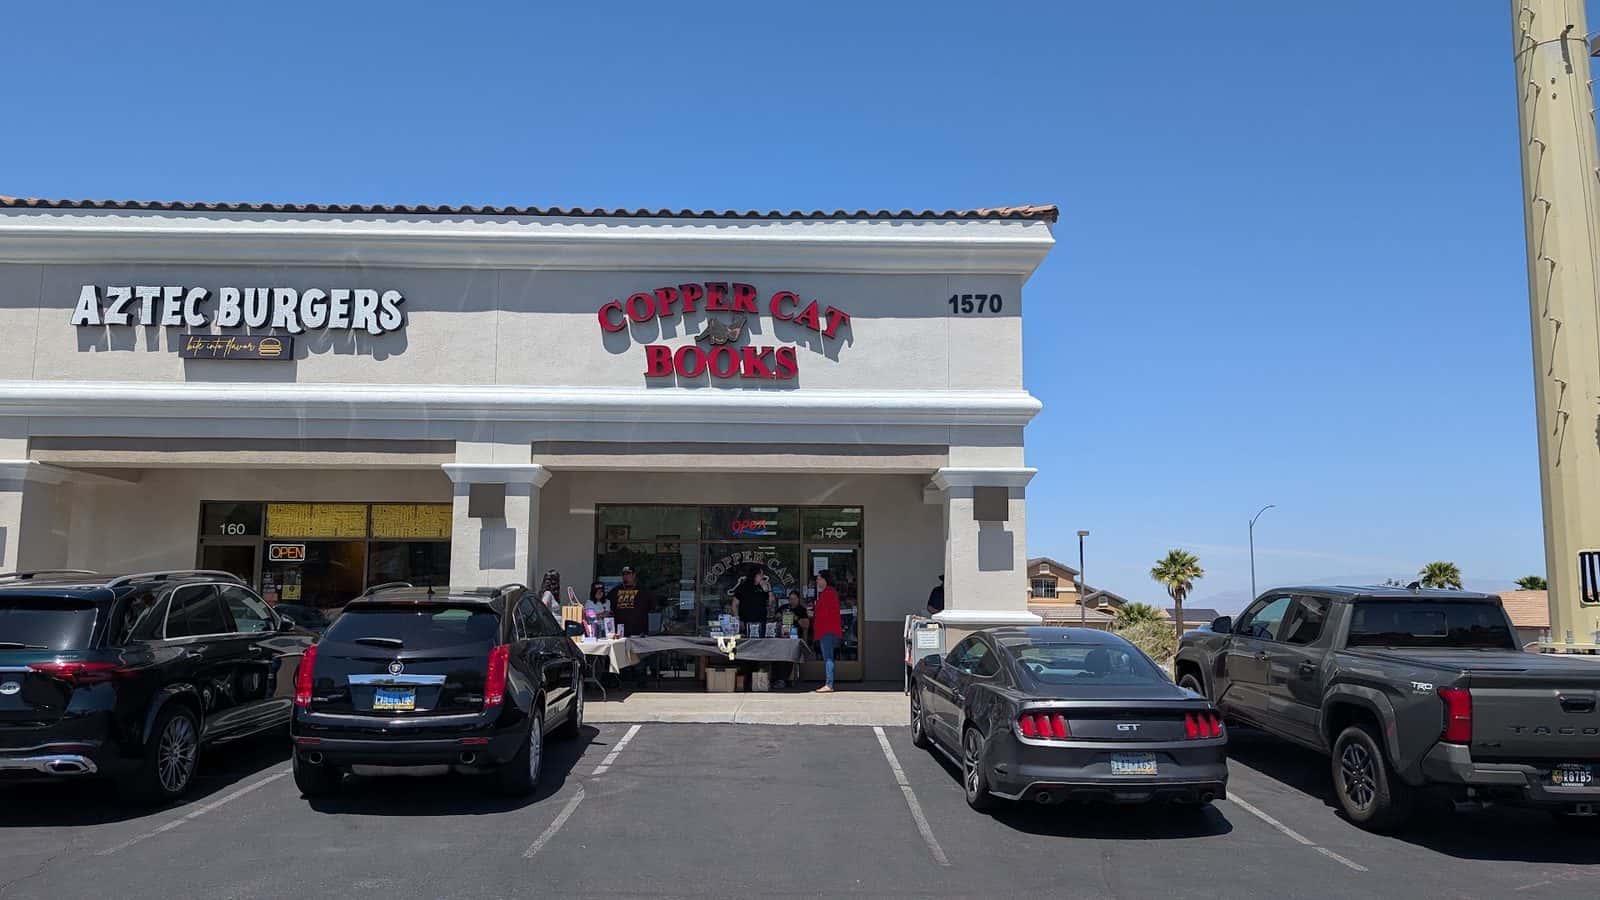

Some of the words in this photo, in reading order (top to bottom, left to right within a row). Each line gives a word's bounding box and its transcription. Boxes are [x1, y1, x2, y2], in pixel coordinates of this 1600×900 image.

[71, 285, 209, 328] AZTEC
[216, 286, 405, 335] BURGERS
[598, 281, 759, 333] COPPER
[769, 291, 850, 340] CAT
[948, 294, 1003, 314] 1570
[186, 336, 204, 357] bite
[206, 337, 222, 357] into
[644, 345, 799, 380] BOOKS
[219, 523, 246, 535] 160
[818, 527, 844, 539] 170
[271, 546, 304, 558] OPEN
[704, 551, 764, 586] COPPER
[767, 558, 795, 586] CAT
[1410, 681, 1433, 691] TRD
[1116, 723, 1141, 731] GT
